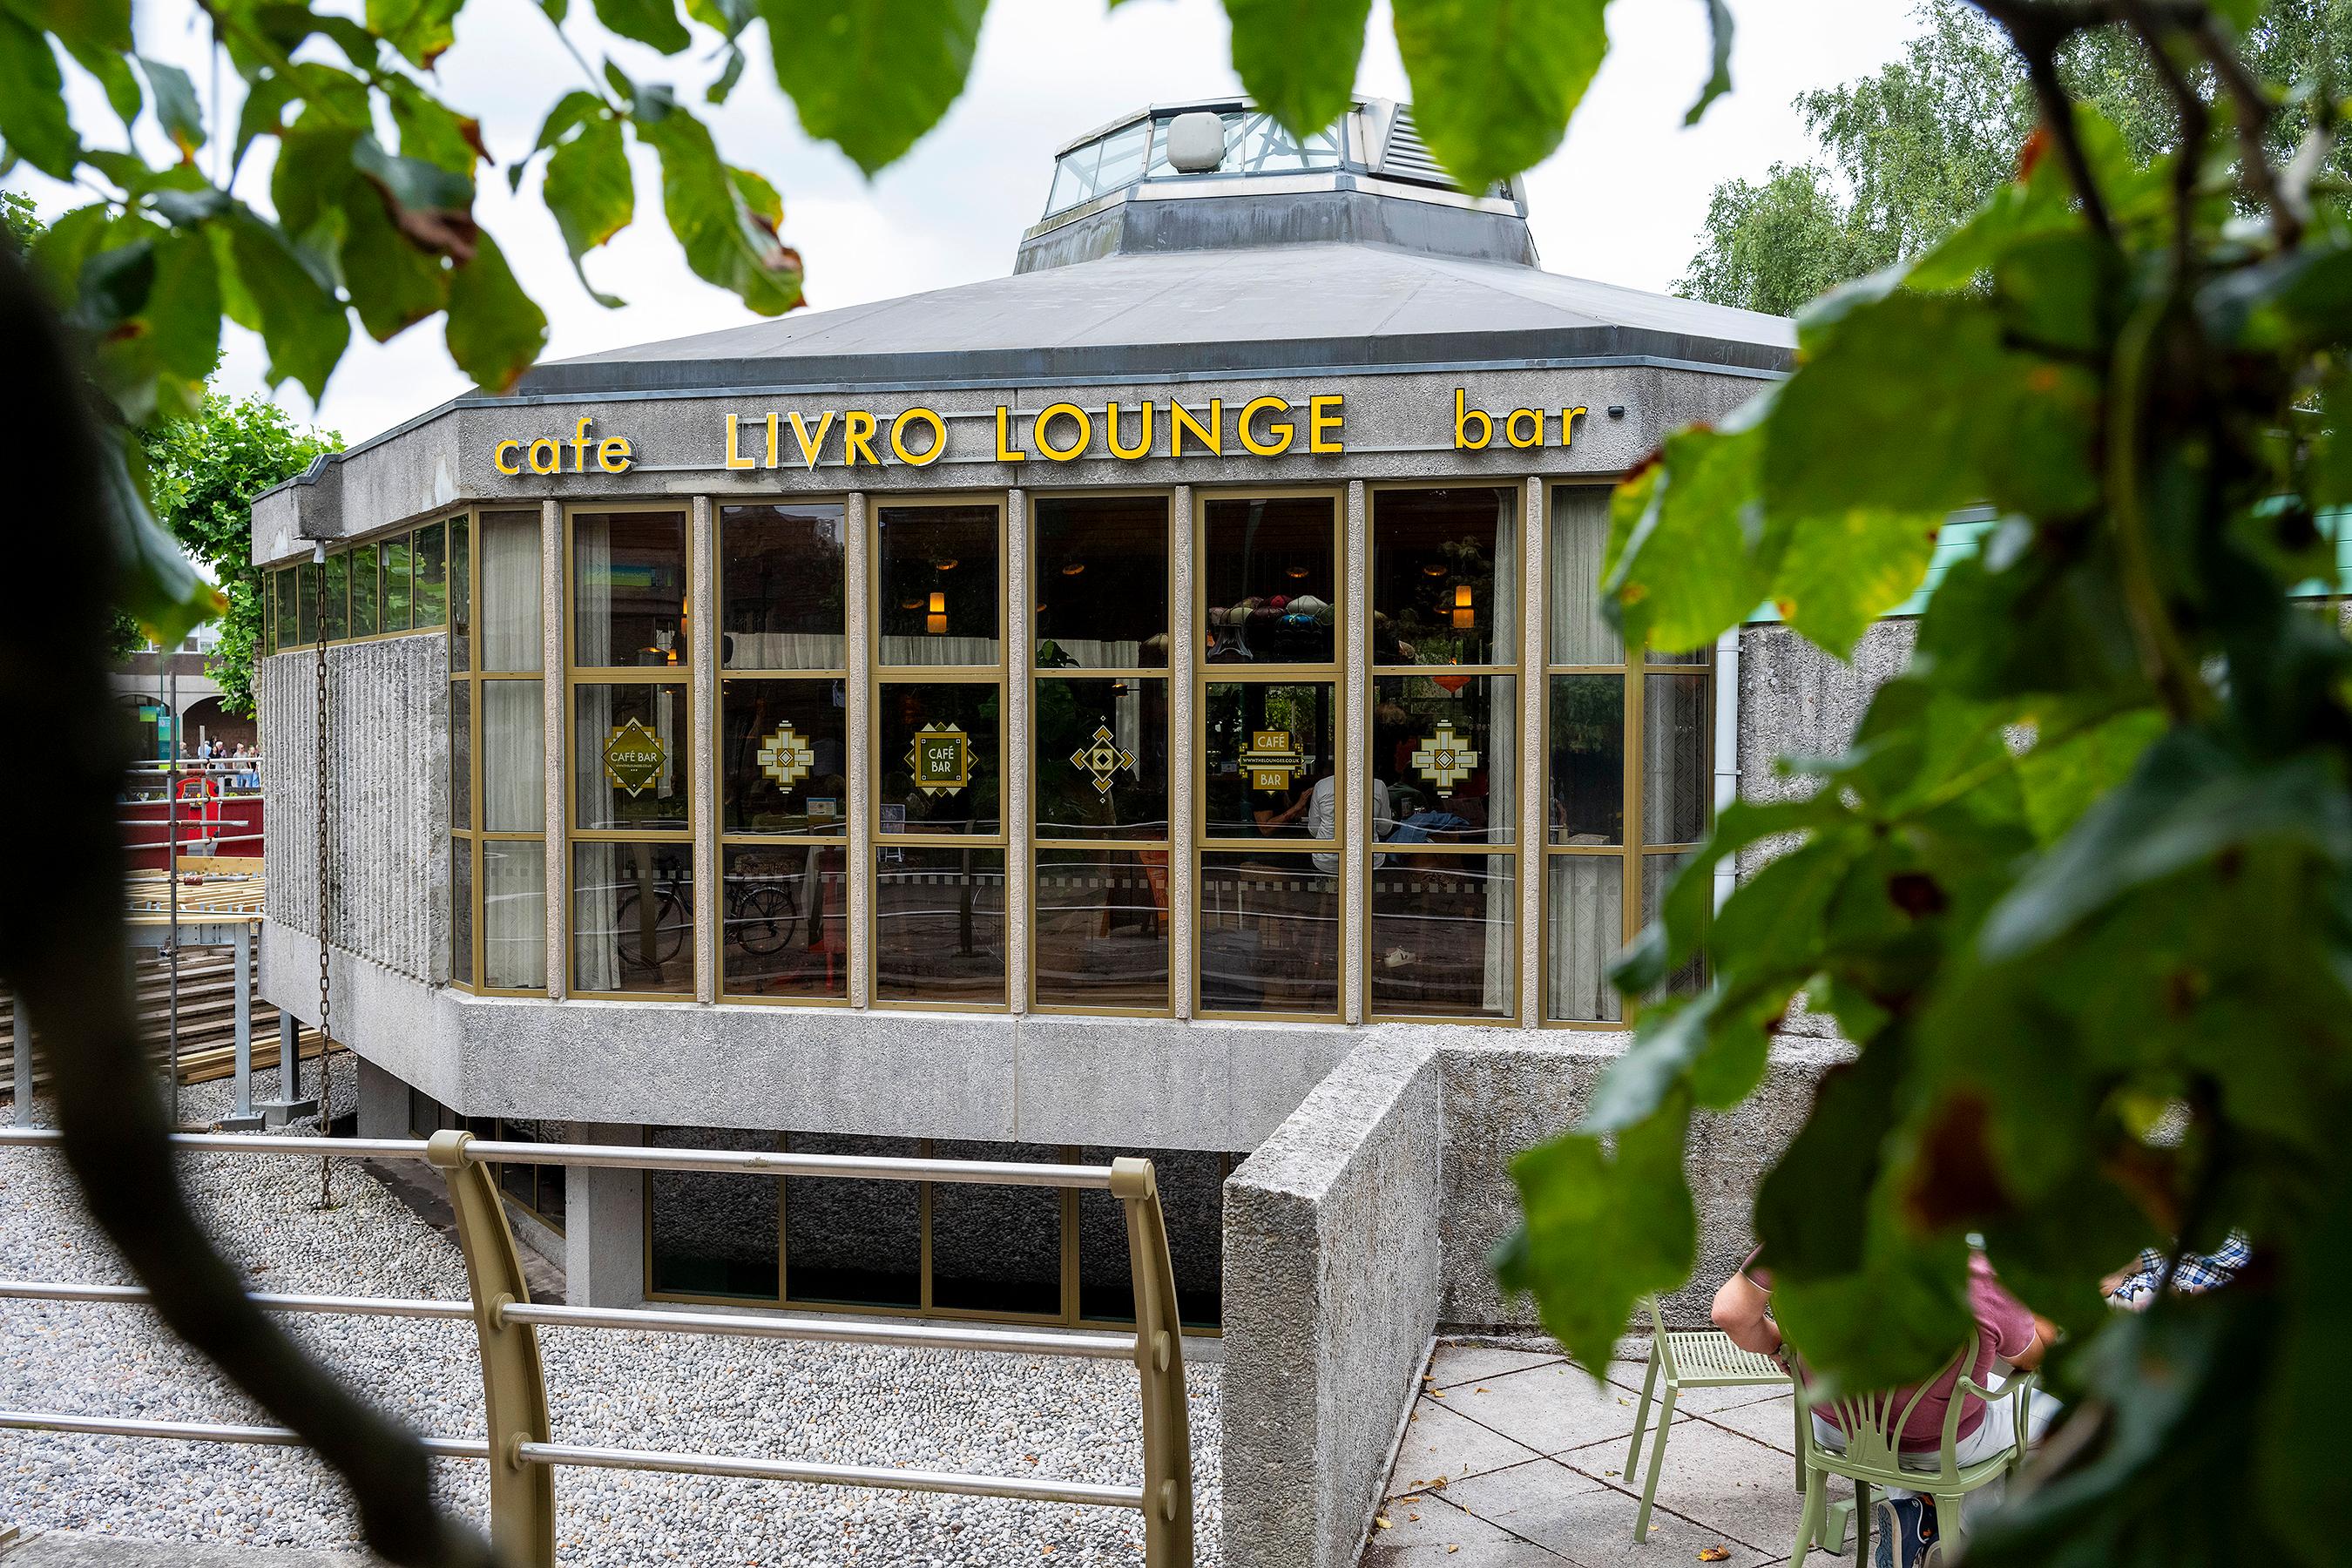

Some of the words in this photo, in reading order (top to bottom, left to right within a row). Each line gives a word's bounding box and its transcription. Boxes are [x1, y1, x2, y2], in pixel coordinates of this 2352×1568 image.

[495, 417, 638, 476] cafe
[725, 406, 951, 473] LIVRO
[995, 394, 1346, 463] LOUNGE
[1454, 387, 1588, 451] bar
[1257, 733, 1285, 747] CAFÉ
[611, 750, 636, 762] CAFÉ
[638, 752, 658, 762] BAR
[929, 746, 954, 760] CAFÉ
[931, 761, 951, 773] BAR
[1260, 774, 1281, 786] BAR
